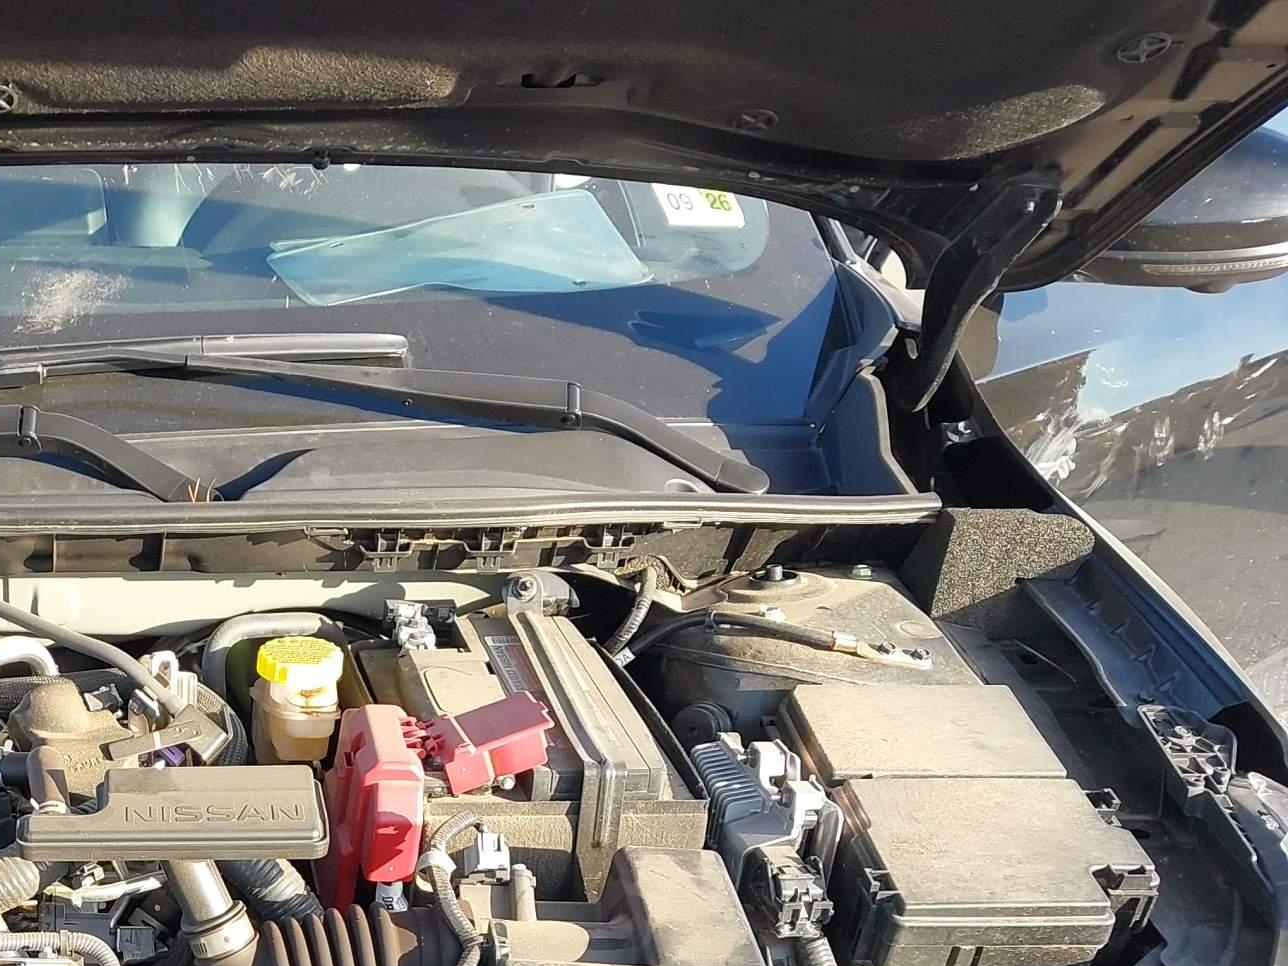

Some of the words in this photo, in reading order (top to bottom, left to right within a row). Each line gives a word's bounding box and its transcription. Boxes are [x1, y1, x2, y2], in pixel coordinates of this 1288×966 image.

[666, 192, 694, 211] 09
[705, 192, 732, 212] 26
[123, 802, 307, 824] NISSAN
